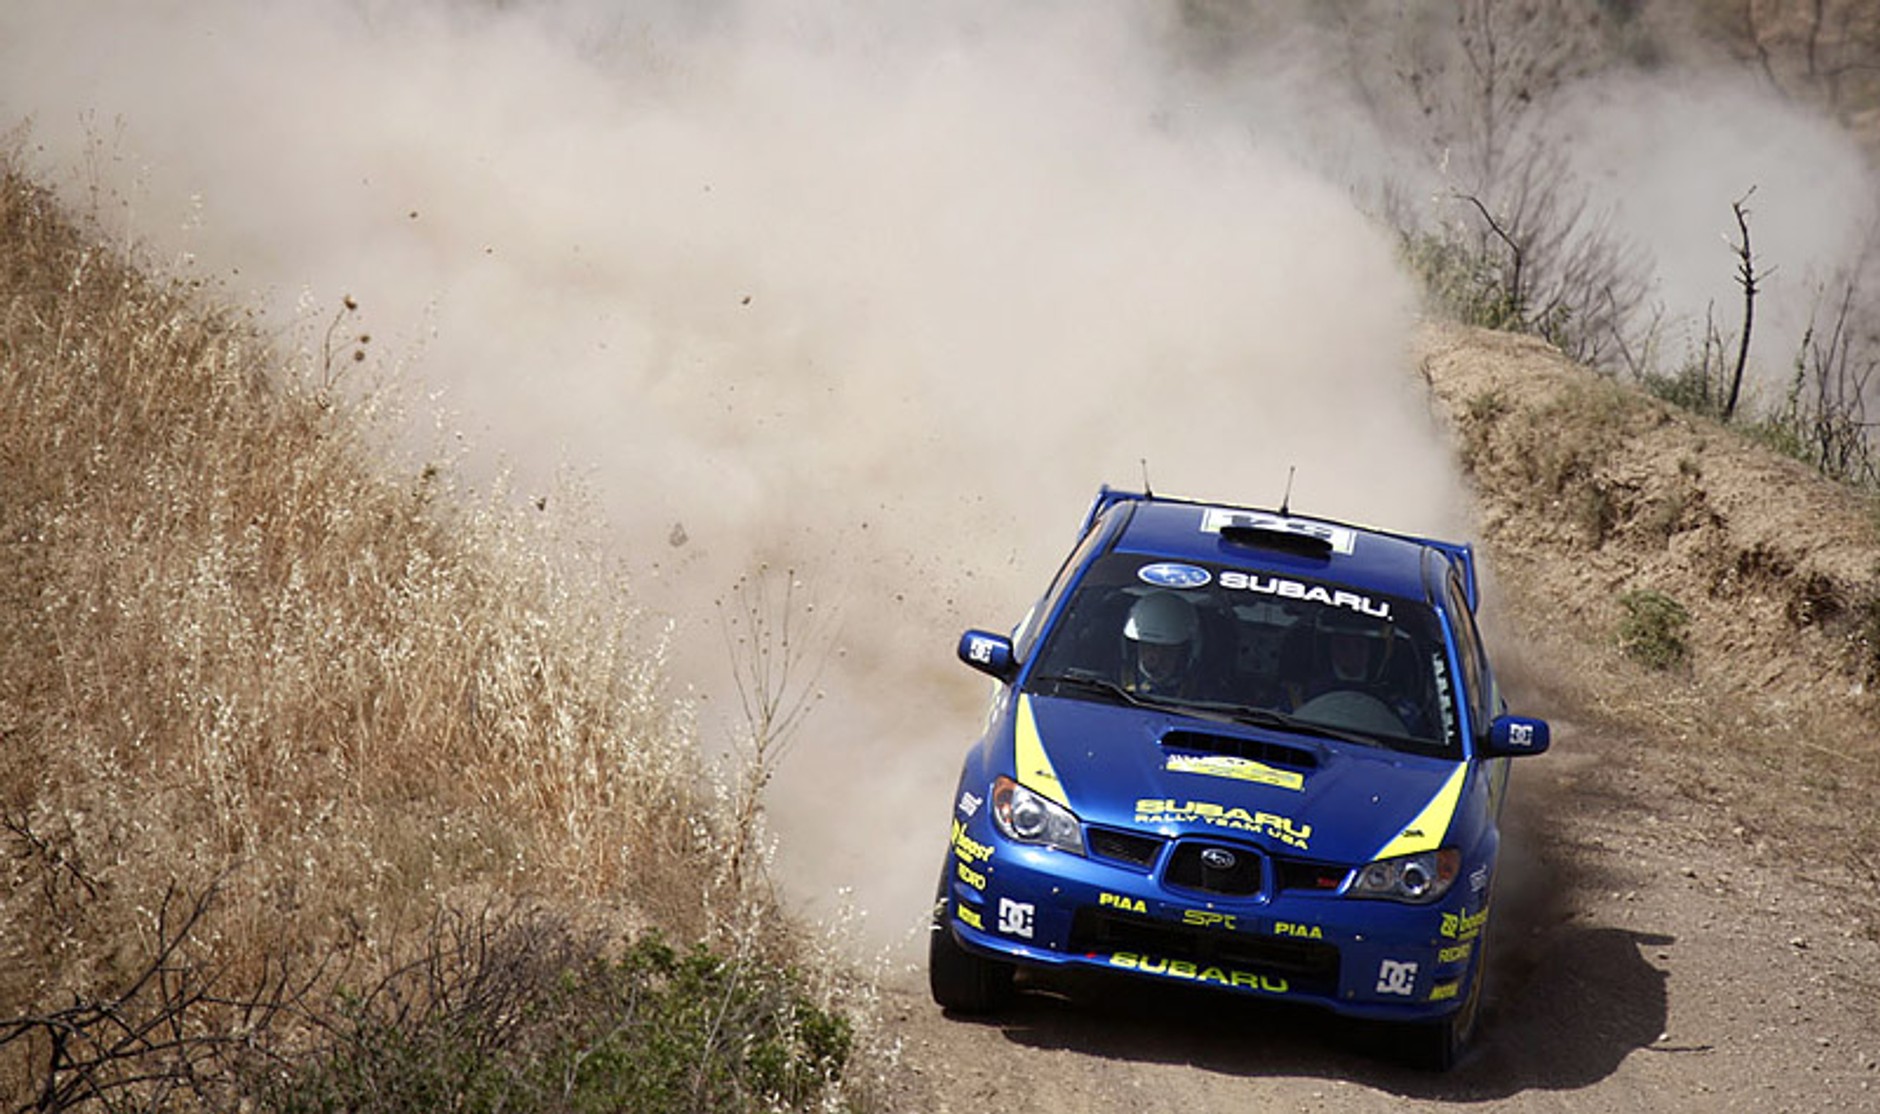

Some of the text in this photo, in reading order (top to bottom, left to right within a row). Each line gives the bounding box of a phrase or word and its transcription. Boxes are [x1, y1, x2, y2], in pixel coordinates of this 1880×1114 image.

[1218, 571, 1391, 618] SUBARU
[1508, 723, 1534, 746] DC
[1134, 813, 1309, 850] RALLY TEAM USA
[1135, 799, 1312, 840] SUBARU
[998, 897, 1036, 939] DC
[1099, 892, 1148, 913] PIAA
[1274, 921, 1323, 939] PIAA
[1109, 952, 1289, 993] SUBARU
[1376, 959, 1418, 995] DC
